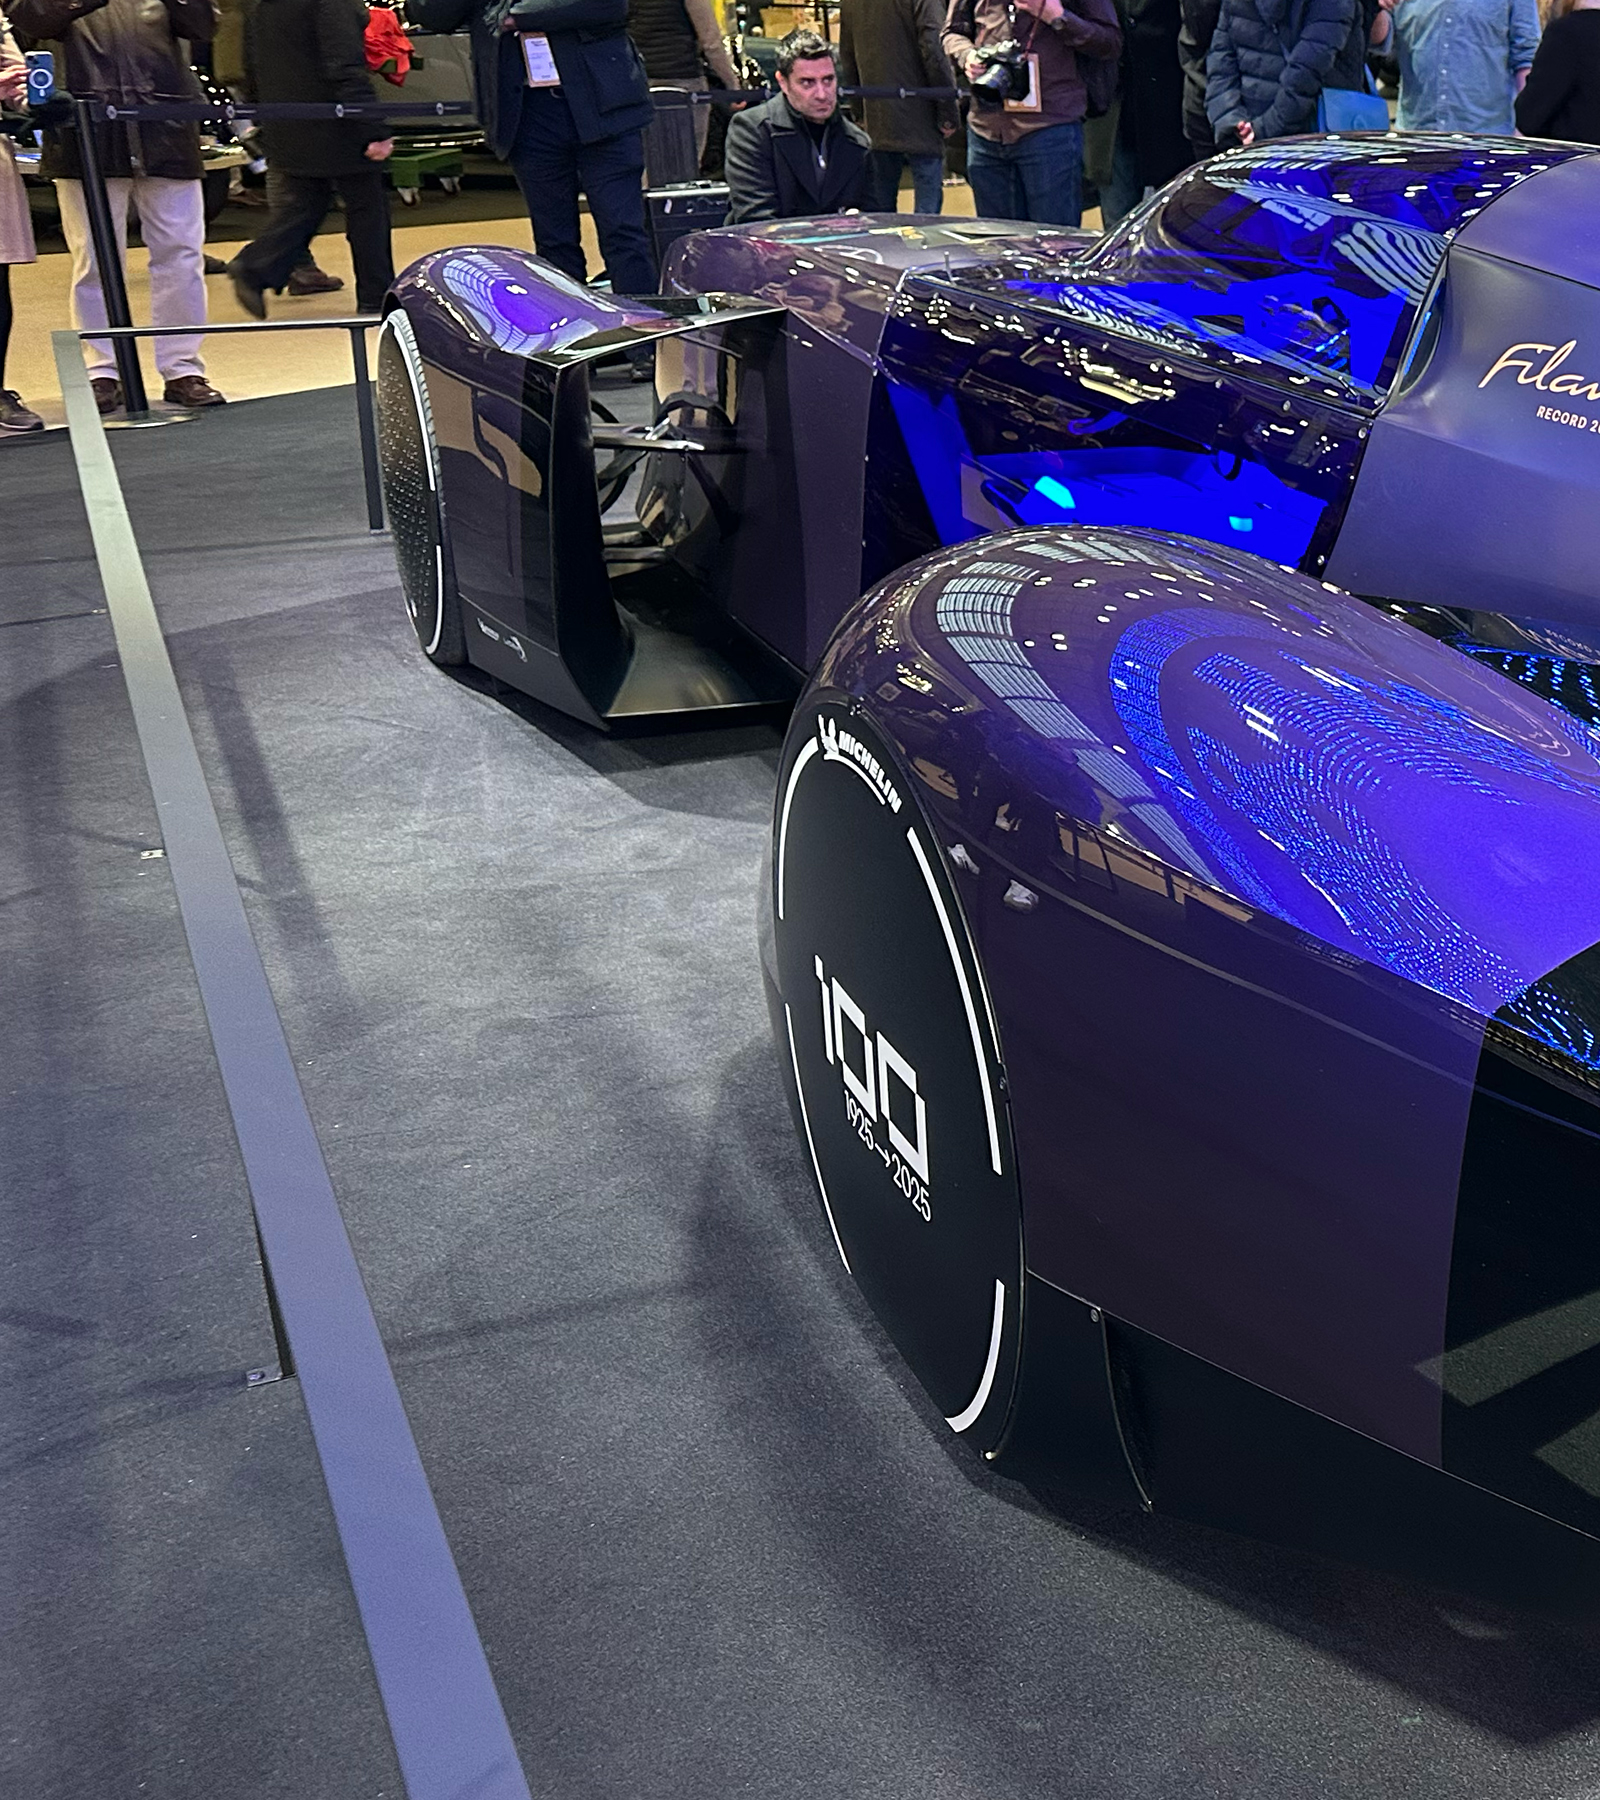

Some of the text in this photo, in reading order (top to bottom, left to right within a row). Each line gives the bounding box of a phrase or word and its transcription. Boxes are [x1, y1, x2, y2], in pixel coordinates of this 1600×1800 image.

[1536, 405, 1588, 429] RECORD
[838, 730, 902, 813] MICHELIN
[814, 954, 930, 1186] 100
